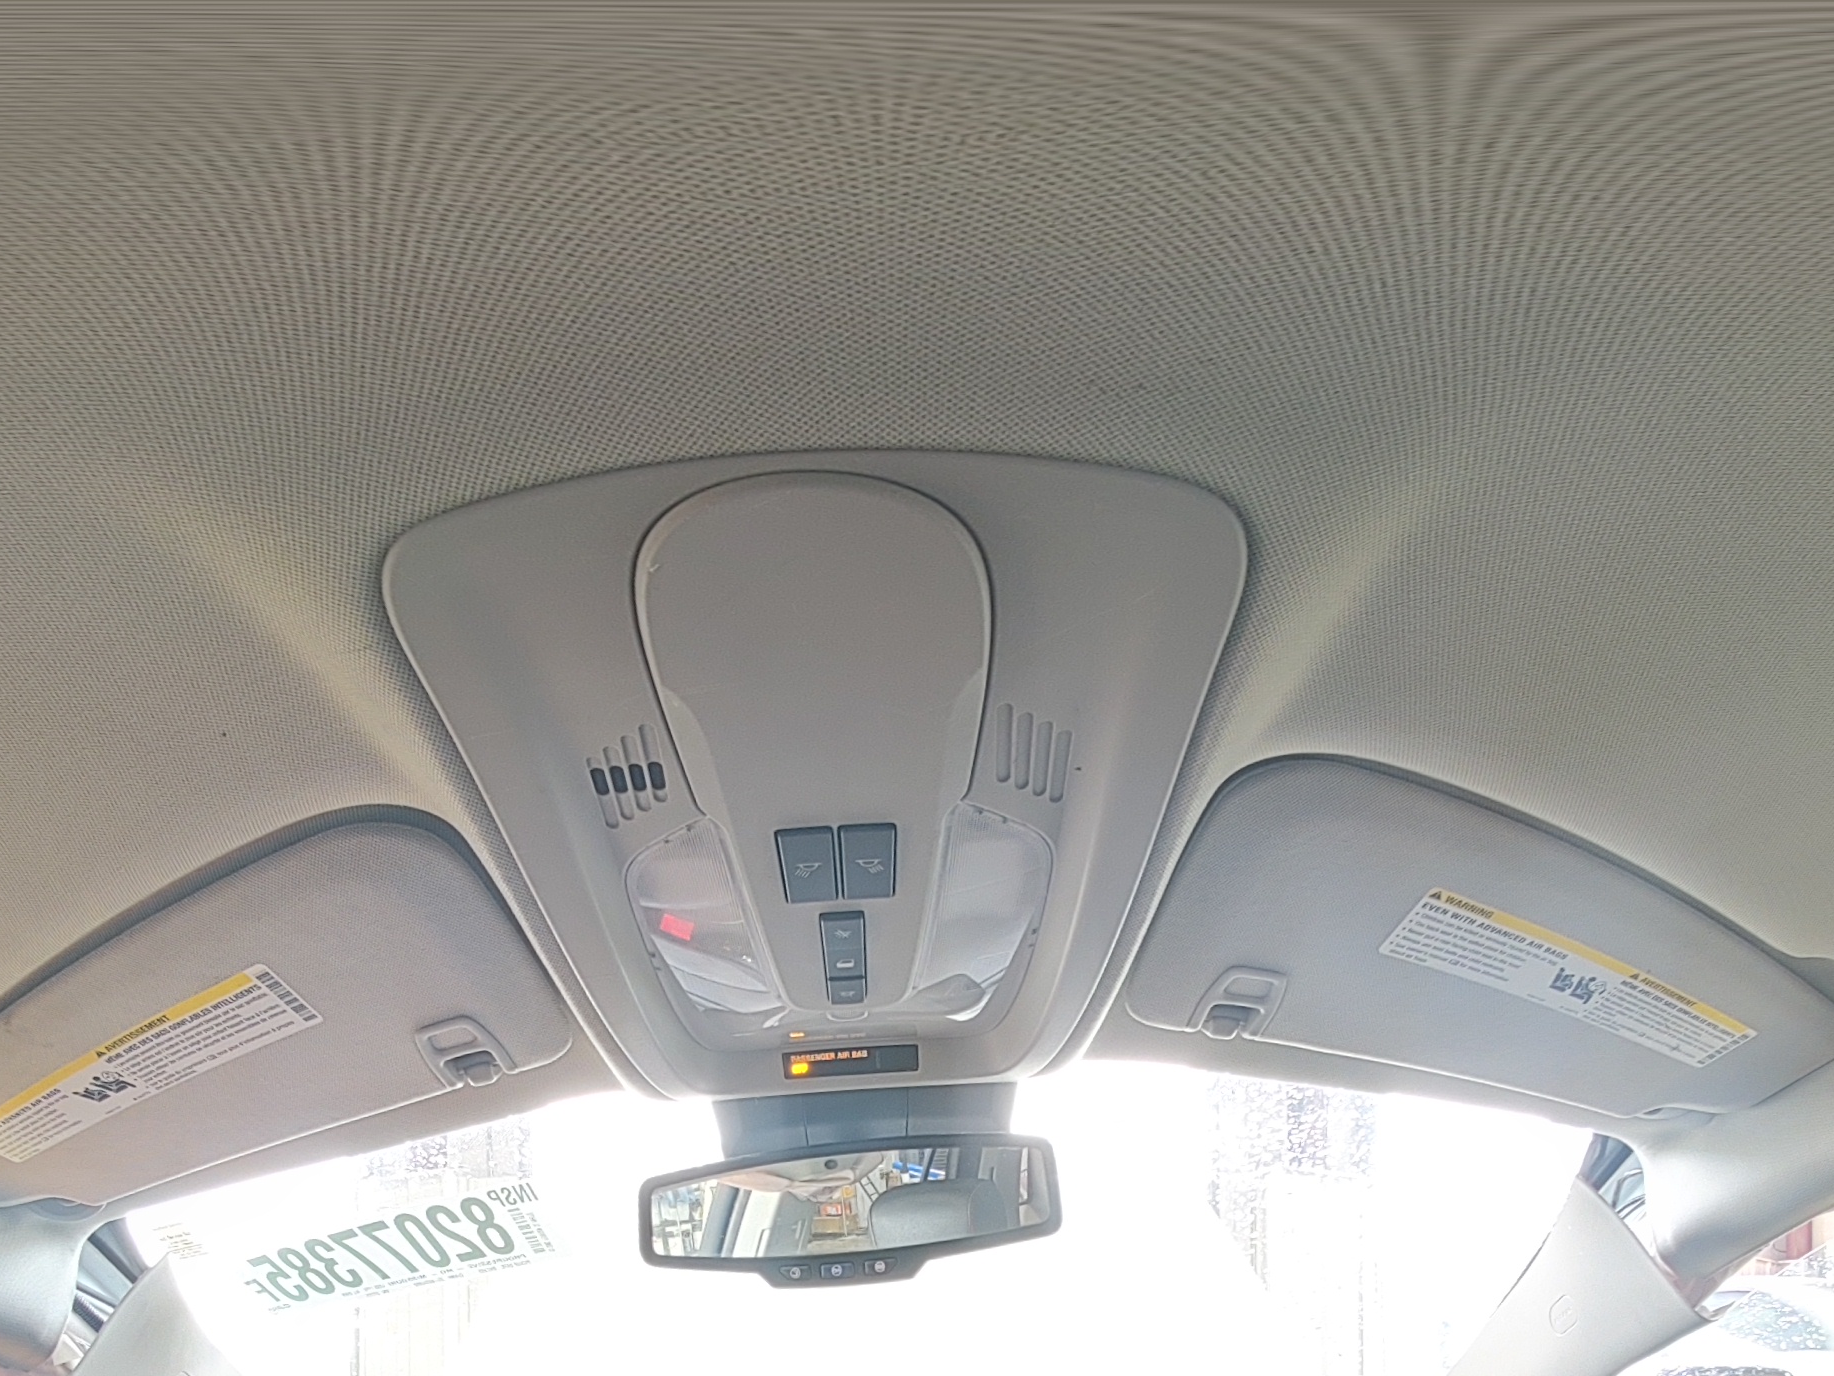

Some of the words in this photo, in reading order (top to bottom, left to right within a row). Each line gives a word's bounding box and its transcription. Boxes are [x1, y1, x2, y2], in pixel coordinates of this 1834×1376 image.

[1445, 895, 1493, 919] WARNING
[1422, 902, 1450, 915] EVEN
[1451, 911, 1477, 925] WITH
[1477, 922, 1527, 943] ADVANCED
[1526, 940, 1545, 950] AIR
[1543, 946, 1569, 960] BAGS
[211, 984, 262, 1014] INTELLIGENTS
[104, 1014, 171, 1053] AVERTISSEMENT
[837, 1051, 851, 1060] AIR
